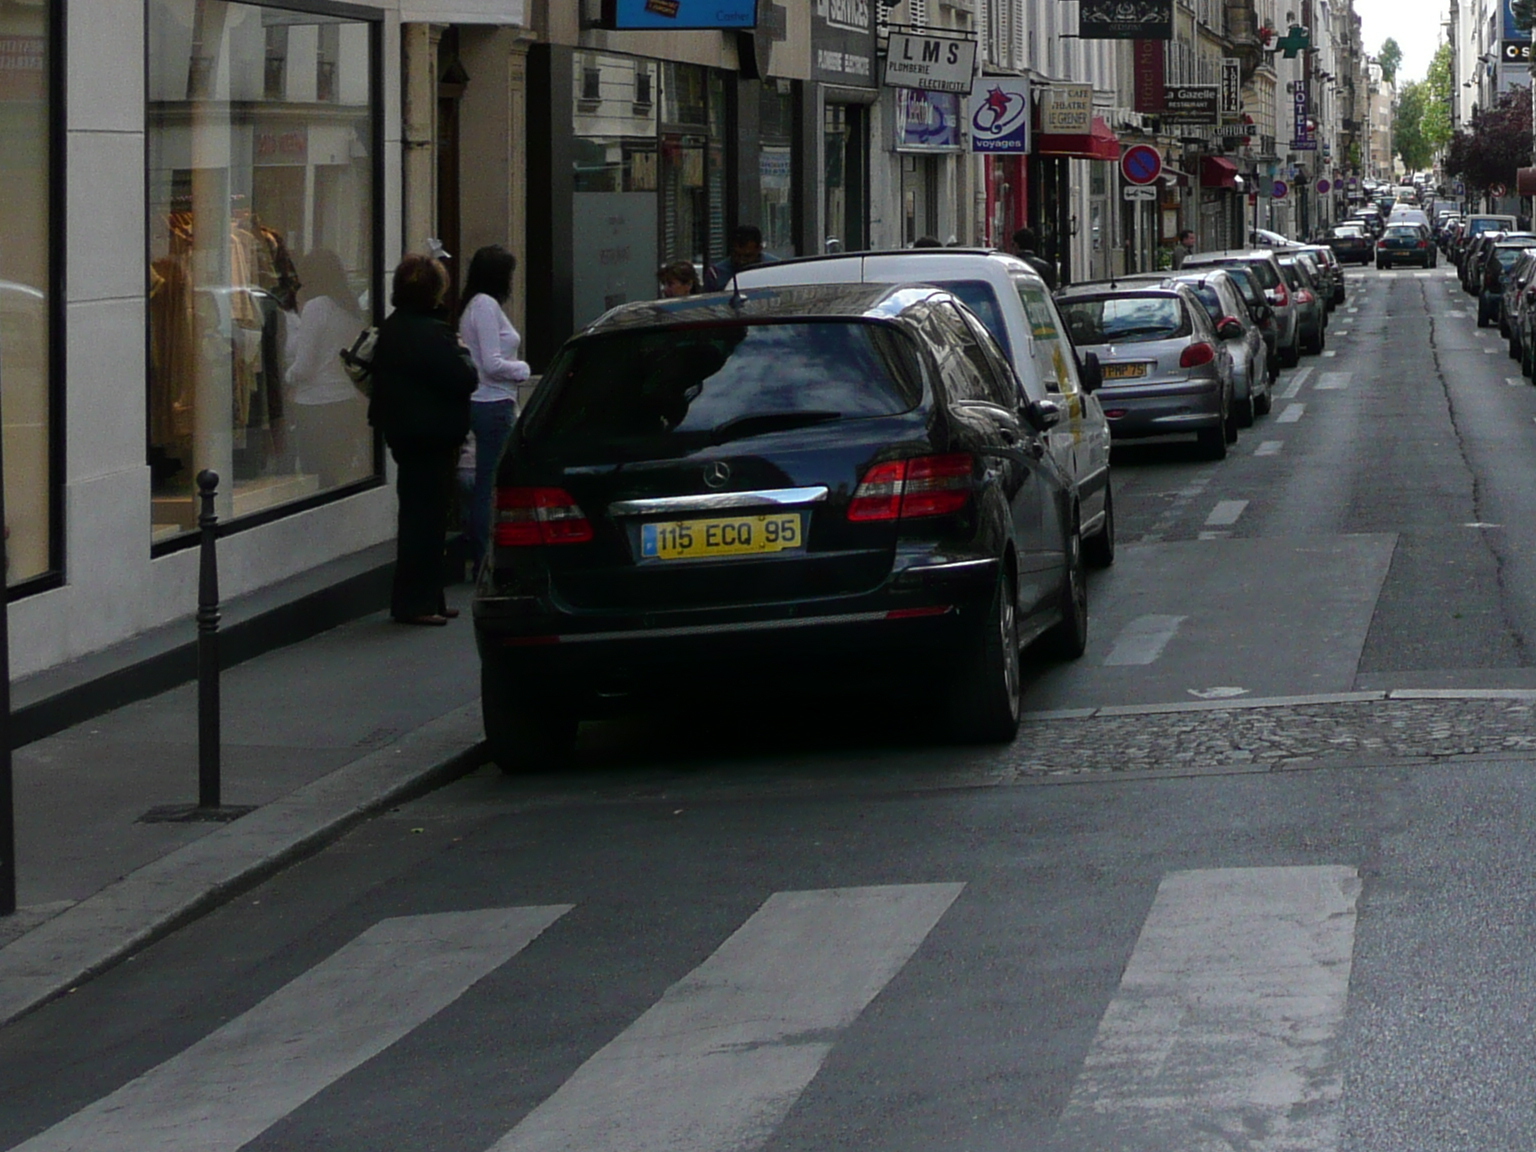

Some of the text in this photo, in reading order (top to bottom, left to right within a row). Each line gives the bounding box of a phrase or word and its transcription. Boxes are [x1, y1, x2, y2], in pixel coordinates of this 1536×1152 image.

[889, 61, 930, 75] PLOMBERIE
[918, 78, 965, 91] ELECTRICITE
[1178, 89, 1215, 99] Gazelle
[1295, 81, 1305, 136] HOTEL
[976, 140, 1021, 149] voyages
[659, 526, 693, 551] 115
[705, 522, 751, 547] ECQ
[764, 519, 796, 544] 95
